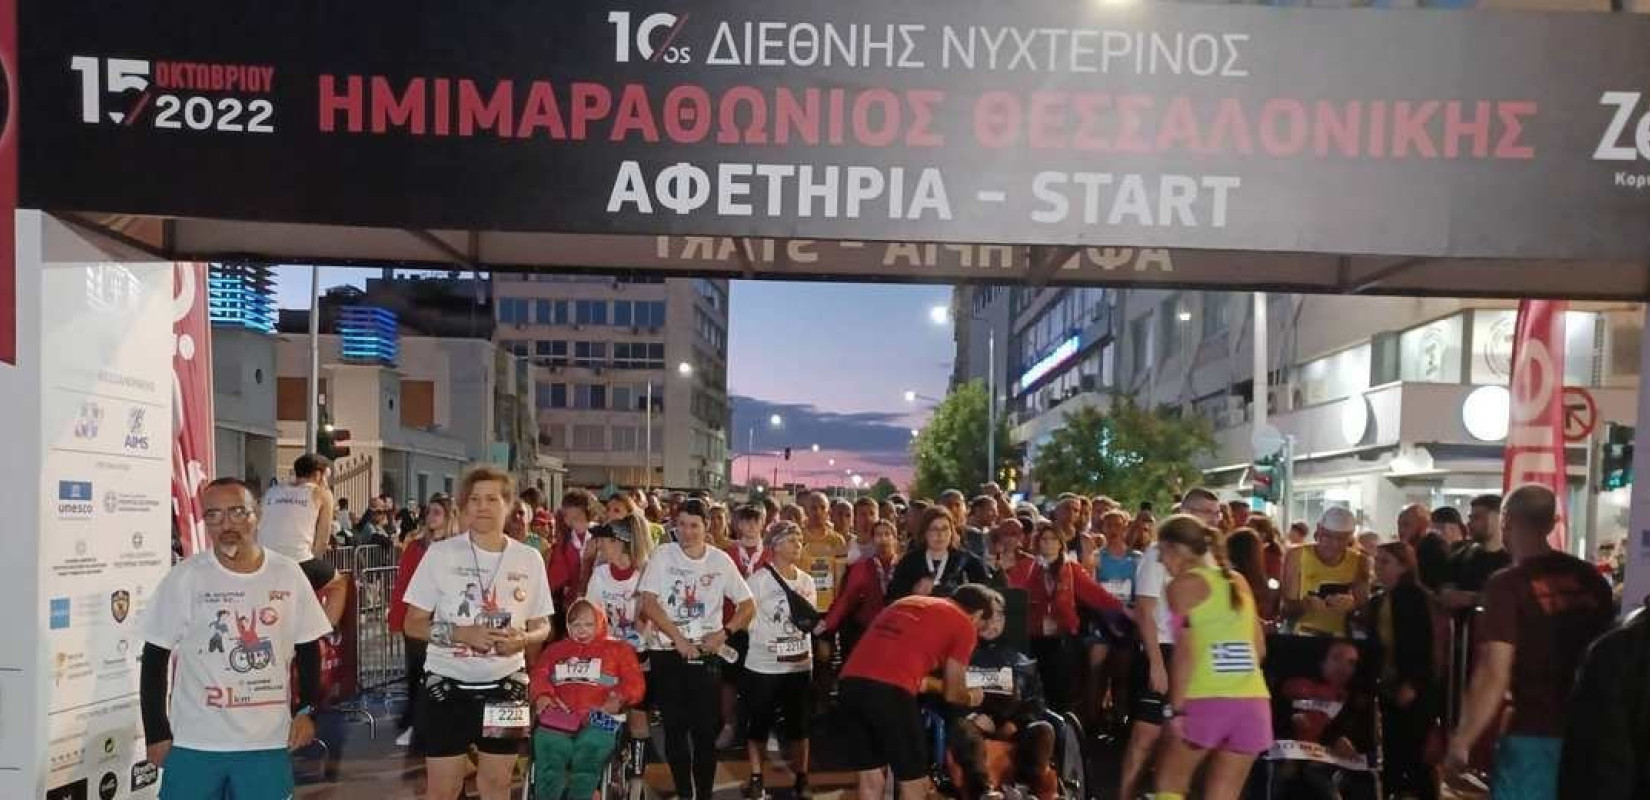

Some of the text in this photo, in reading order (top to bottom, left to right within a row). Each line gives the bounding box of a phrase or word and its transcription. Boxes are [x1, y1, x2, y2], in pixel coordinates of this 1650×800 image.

[155, 61, 274, 92] ΟΚΤΩΒΡΙΟΥ
[705, 20, 925, 68] ΔΙΕΘΝΗΣ
[942, 27, 1250, 77] ΝΥΧΤΕΡΙΝΟΣ
[71, 55, 150, 125] 15
[154, 94, 275, 133] 2022
[318, 73, 1538, 160] ΗΜΙΜΑΡΑΘΩΝΙΟΣ ΘΕΣΣΑΛΟΝΙΚΗΣ
[606, 160, 953, 222] ΑΦΕΤΗΡΙΑ
[1030, 169, 1241, 228] START
[59, 504, 94, 514] unesco
